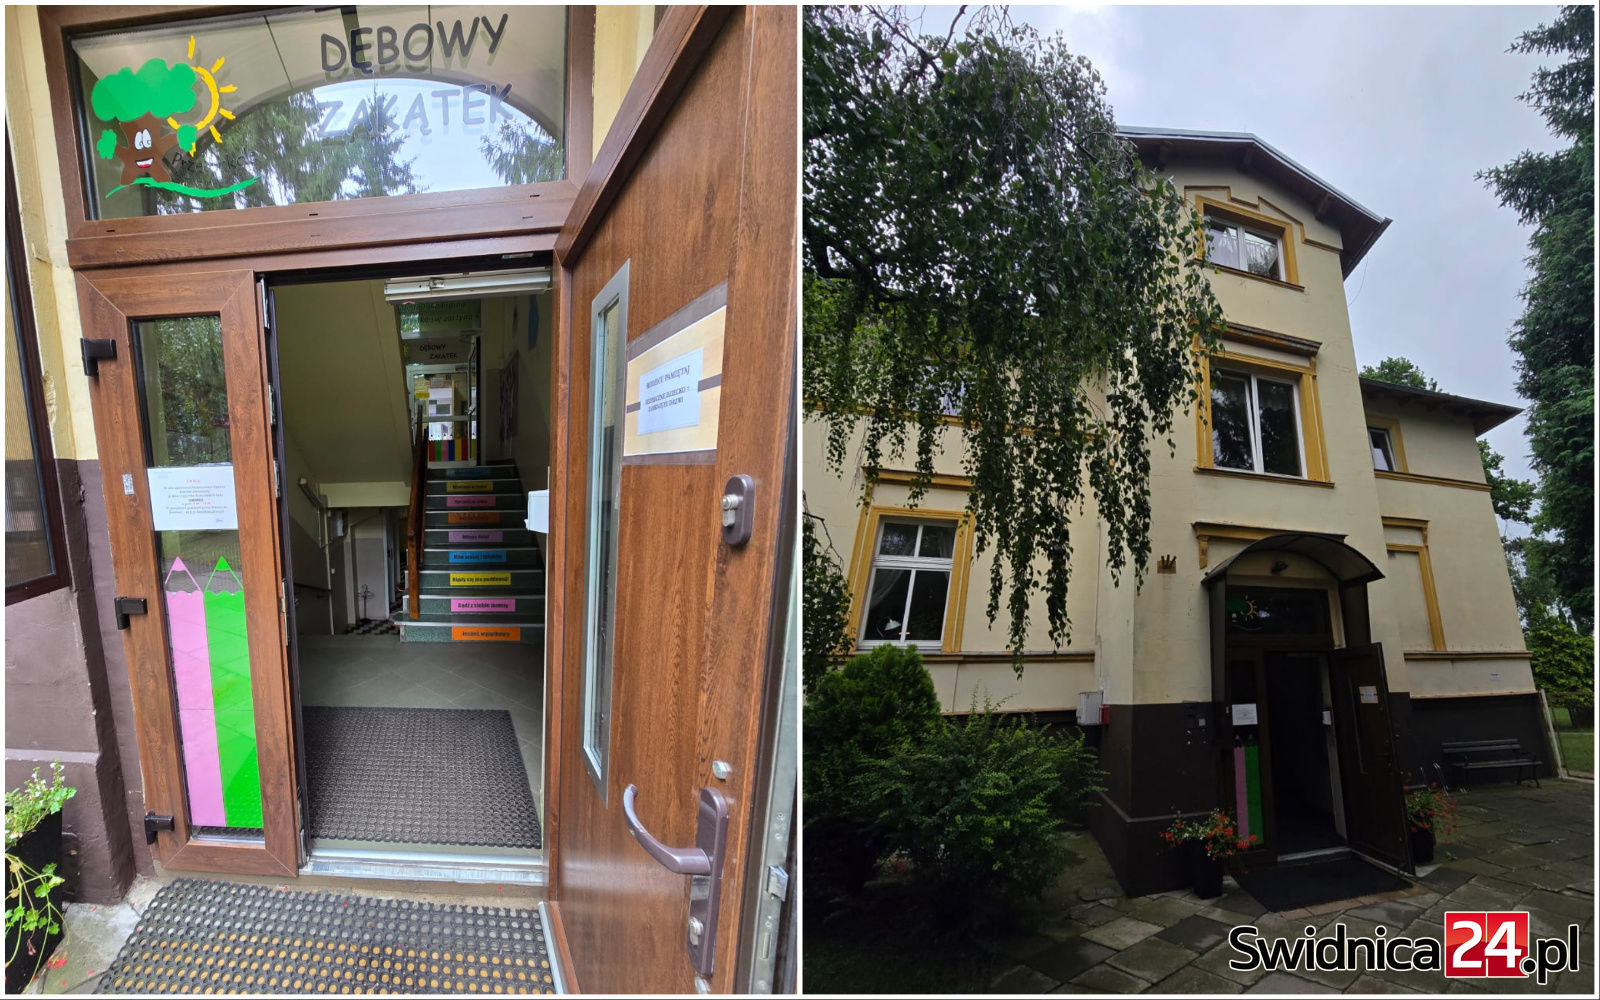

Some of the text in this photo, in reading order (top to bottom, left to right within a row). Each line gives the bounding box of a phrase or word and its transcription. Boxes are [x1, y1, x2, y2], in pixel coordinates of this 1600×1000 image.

[320, 13, 510, 75] DĘBOWY
[317, 83, 515, 138] ZAKĄTEK
[420, 344, 446, 352] DĘBOWY
[664, 365, 690, 381] PAMIĘTAJ
